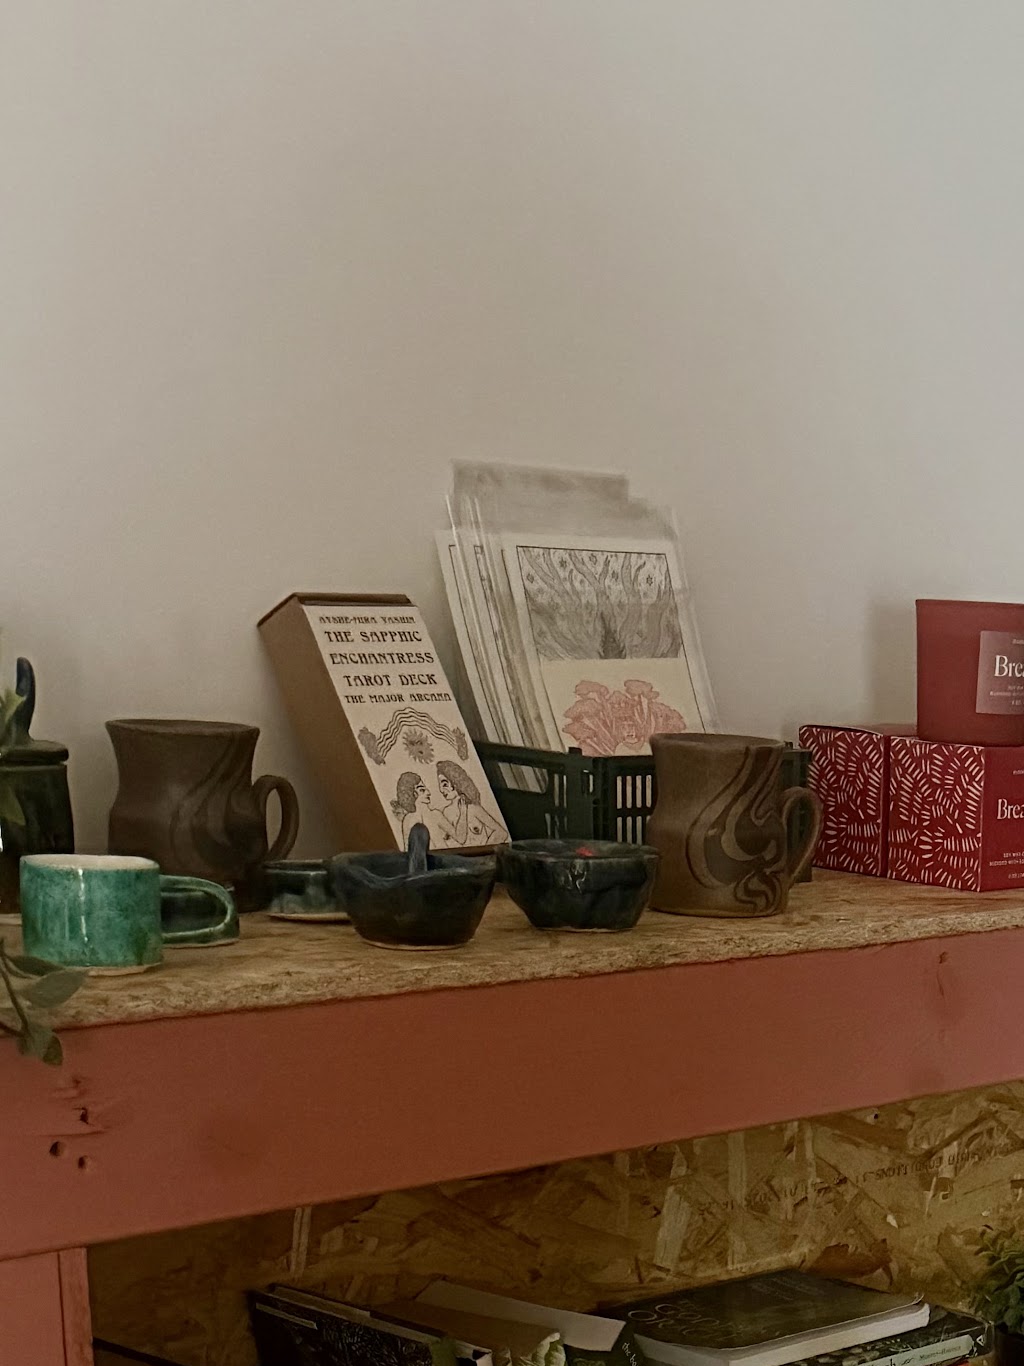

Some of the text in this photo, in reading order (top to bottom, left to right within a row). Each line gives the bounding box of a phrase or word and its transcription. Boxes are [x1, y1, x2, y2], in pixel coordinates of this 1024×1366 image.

[324, 631, 422, 643] THE SAPPHIC
[329, 653, 434, 665] ENCHANTRESS
[343, 674, 437, 687] TAROT DECK
[343, 693, 452, 704] THE MAJOR ARCANA
[618, 1341, 637, 1358] the
